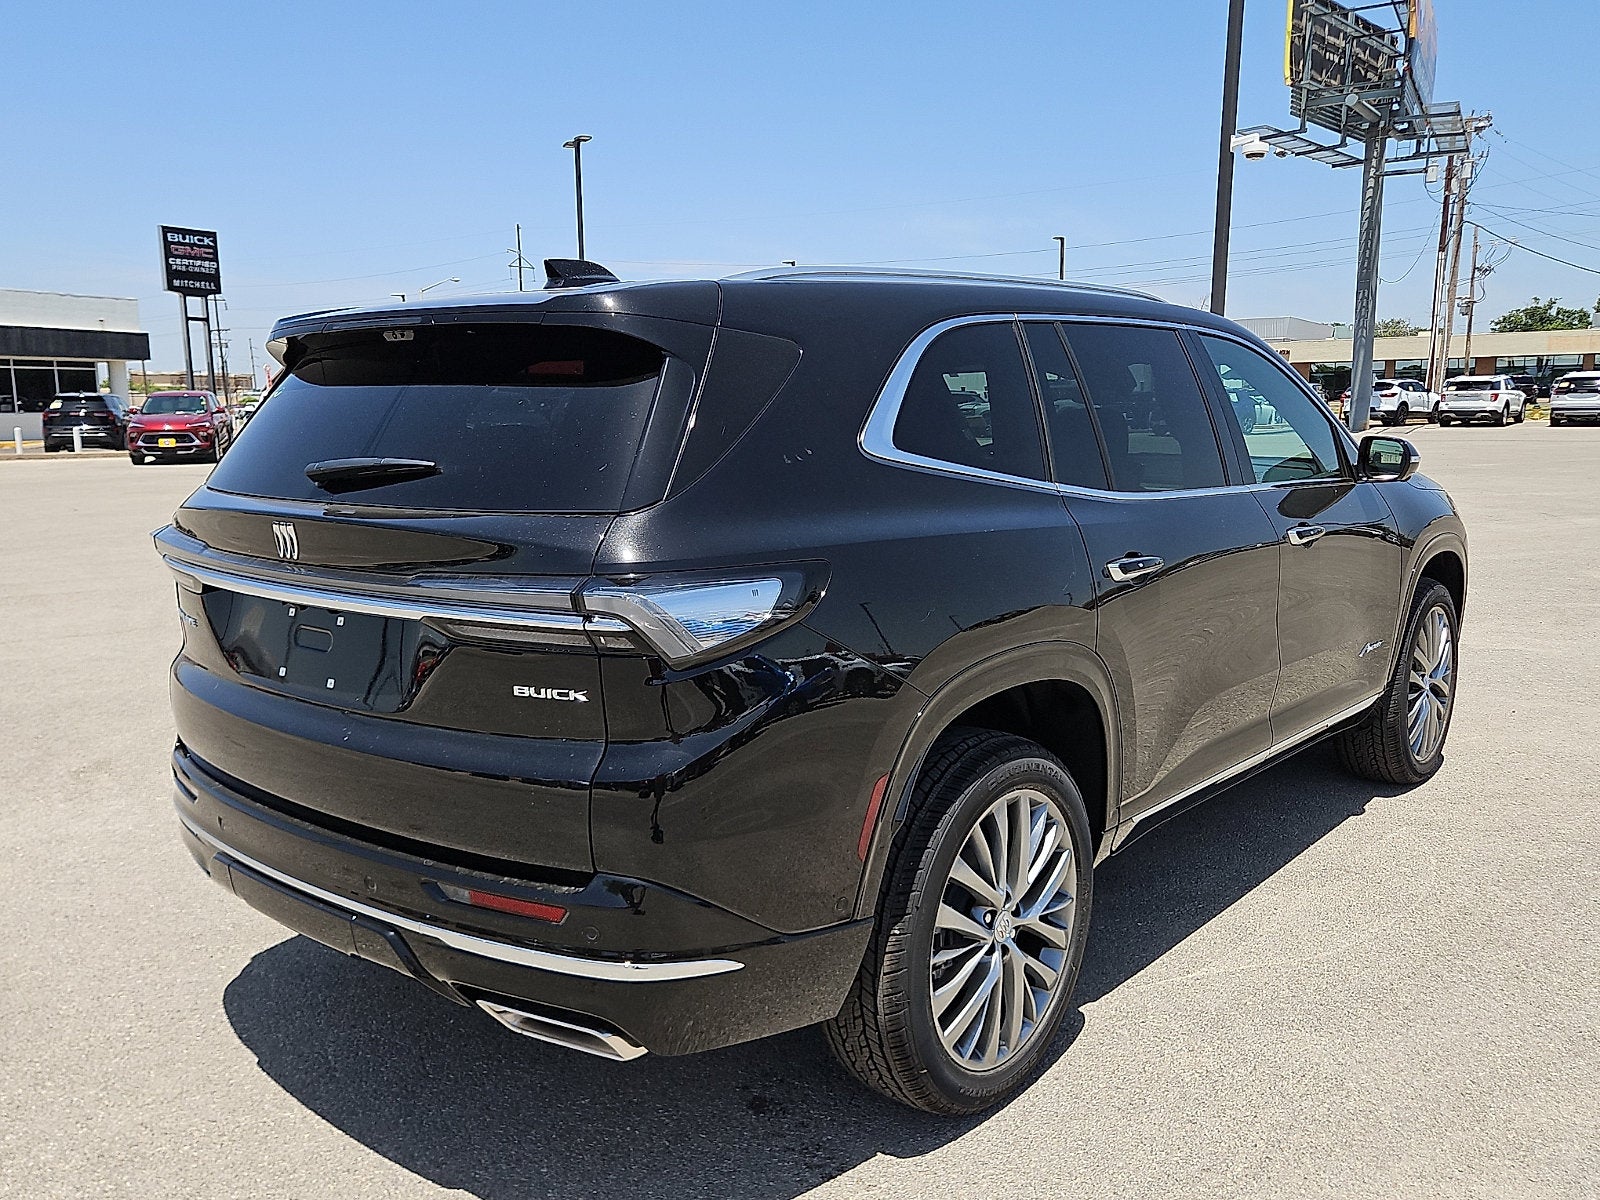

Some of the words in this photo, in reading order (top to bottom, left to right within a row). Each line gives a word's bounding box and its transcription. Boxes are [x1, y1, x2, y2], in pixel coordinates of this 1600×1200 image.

[167, 233, 215, 246] BUICK
[170, 245, 214, 258] GMC
[169, 258, 217, 268] CERTIFIED
[173, 279, 217, 290] MITCHELL
[513, 685, 590, 702] BUICK
